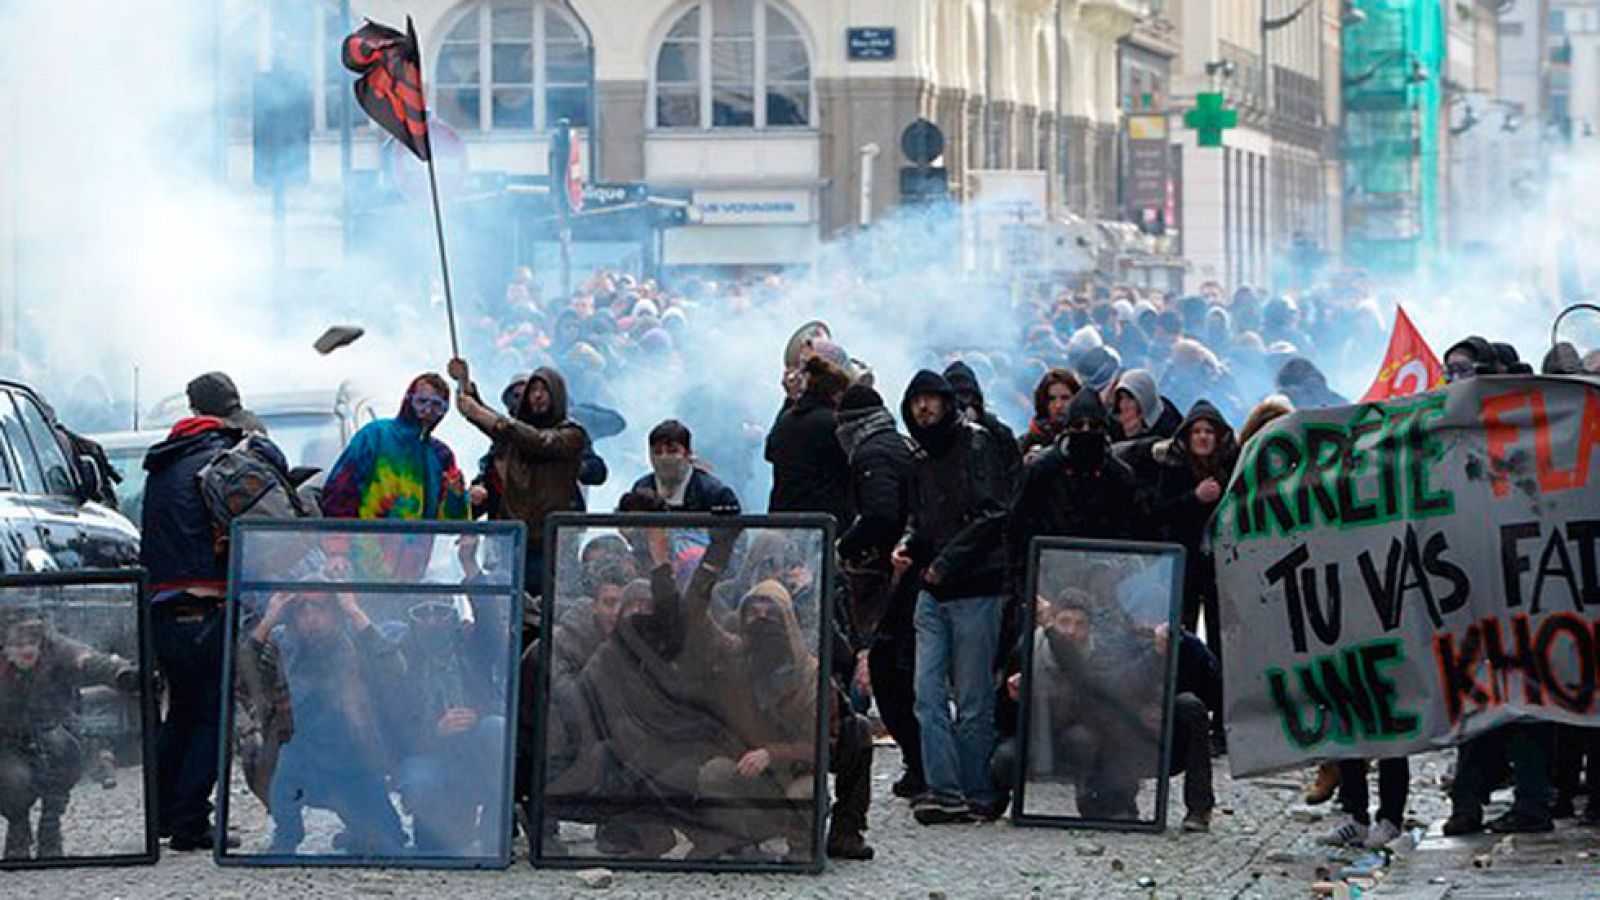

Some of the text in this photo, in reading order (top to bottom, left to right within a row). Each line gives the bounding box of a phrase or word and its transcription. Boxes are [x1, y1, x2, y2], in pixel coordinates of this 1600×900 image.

[1265, 544, 1341, 653] TU
[1357, 523, 1470, 632] VAS
[1267, 612, 1600, 746] UNE KHO
